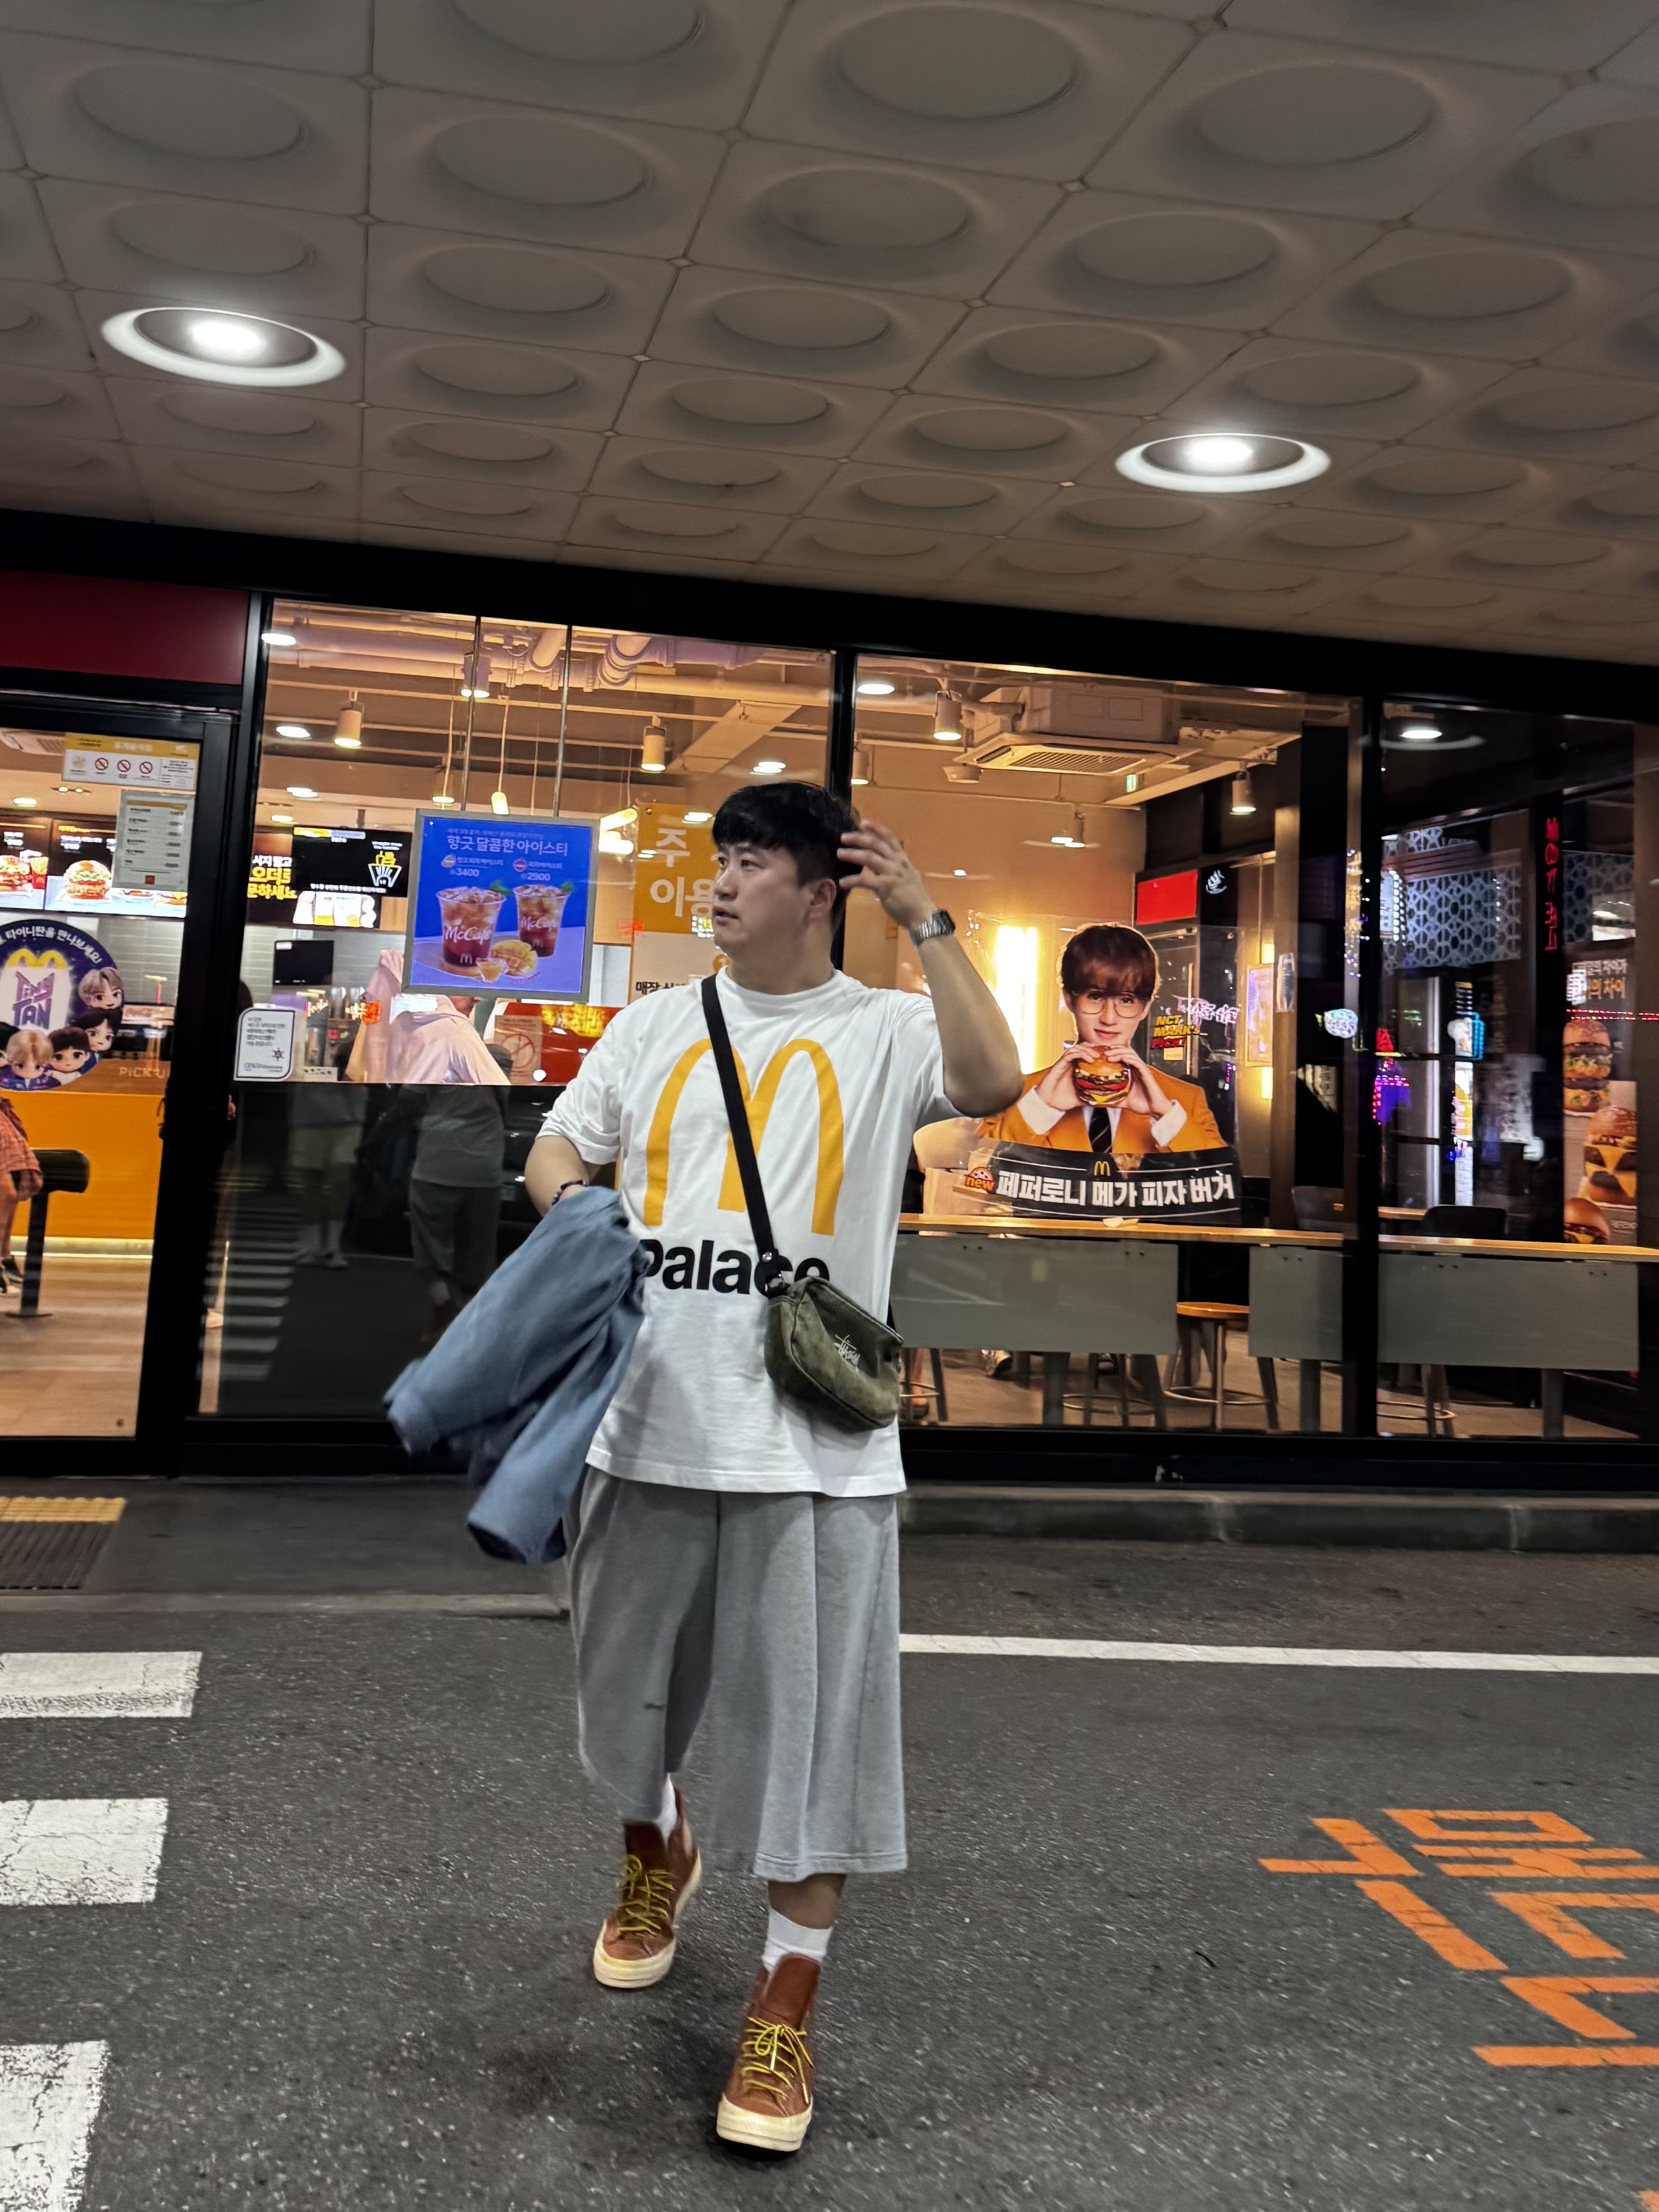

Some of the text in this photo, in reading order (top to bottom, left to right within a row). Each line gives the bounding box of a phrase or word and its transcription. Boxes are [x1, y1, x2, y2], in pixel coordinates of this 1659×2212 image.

[476, 837, 515, 853] 달콤한
[516, 839, 568, 857] 아이스티
[456, 868, 480, 877] 3400
[1155, 1015, 1182, 1026] NCT
[996, 1170, 1236, 1207] 페퍼로니 메가 피자 버거
